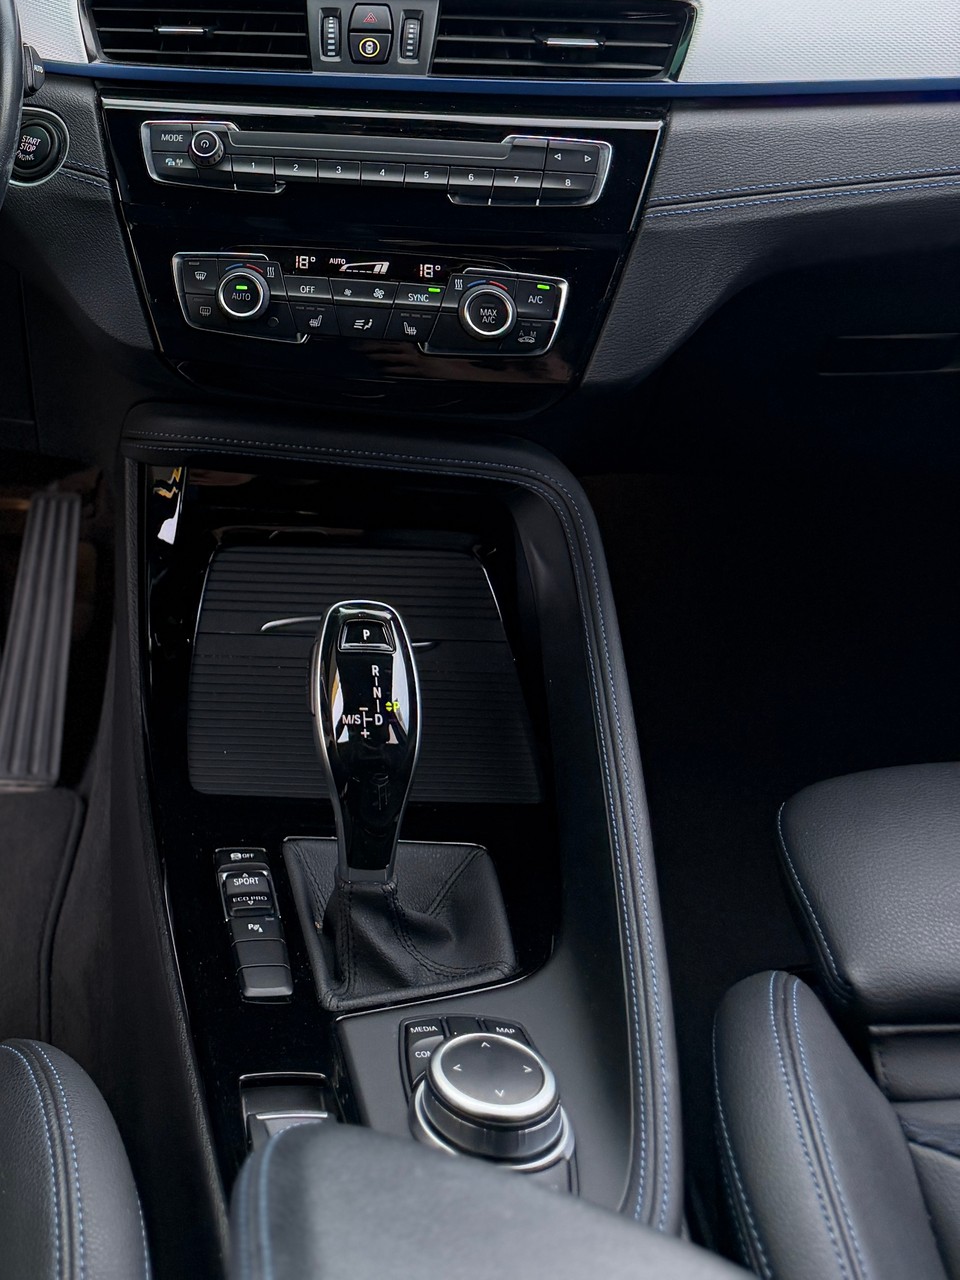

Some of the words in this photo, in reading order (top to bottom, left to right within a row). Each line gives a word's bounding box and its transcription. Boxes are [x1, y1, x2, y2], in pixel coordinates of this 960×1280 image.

[22, 135, 41, 146] START
[161, 133, 184, 142] MODE
[20, 142, 36, 152] STOP
[293, 163, 299, 172] 2
[336, 166, 342, 174] 3
[379, 169, 385, 177] 4
[423, 171, 430, 179] 5
[468, 173, 474, 182] 6
[513, 175, 520, 184] 7
[565, 178, 571, 187] 8
[329, 257, 346, 265] AUTO
[300, 285, 315, 294] OFF
[231, 292, 251, 301] AUTO
[408, 294, 429, 302] SYNC
[528, 295, 543, 304] A/C
[479, 308, 497, 317] MAX
[482, 316, 495, 324] A/C
[363, 629, 370, 640] P
[371, 665, 379, 677] R
[373, 687, 382, 699] N
[393, 701, 400, 712] P
[342, 714, 361, 725] M/S
[374, 714, 383, 726] D
[233, 877, 259, 886] SPORT
[410, 1025, 438, 1033] MEDIA
[496, 1026, 515, 1034] MAP
